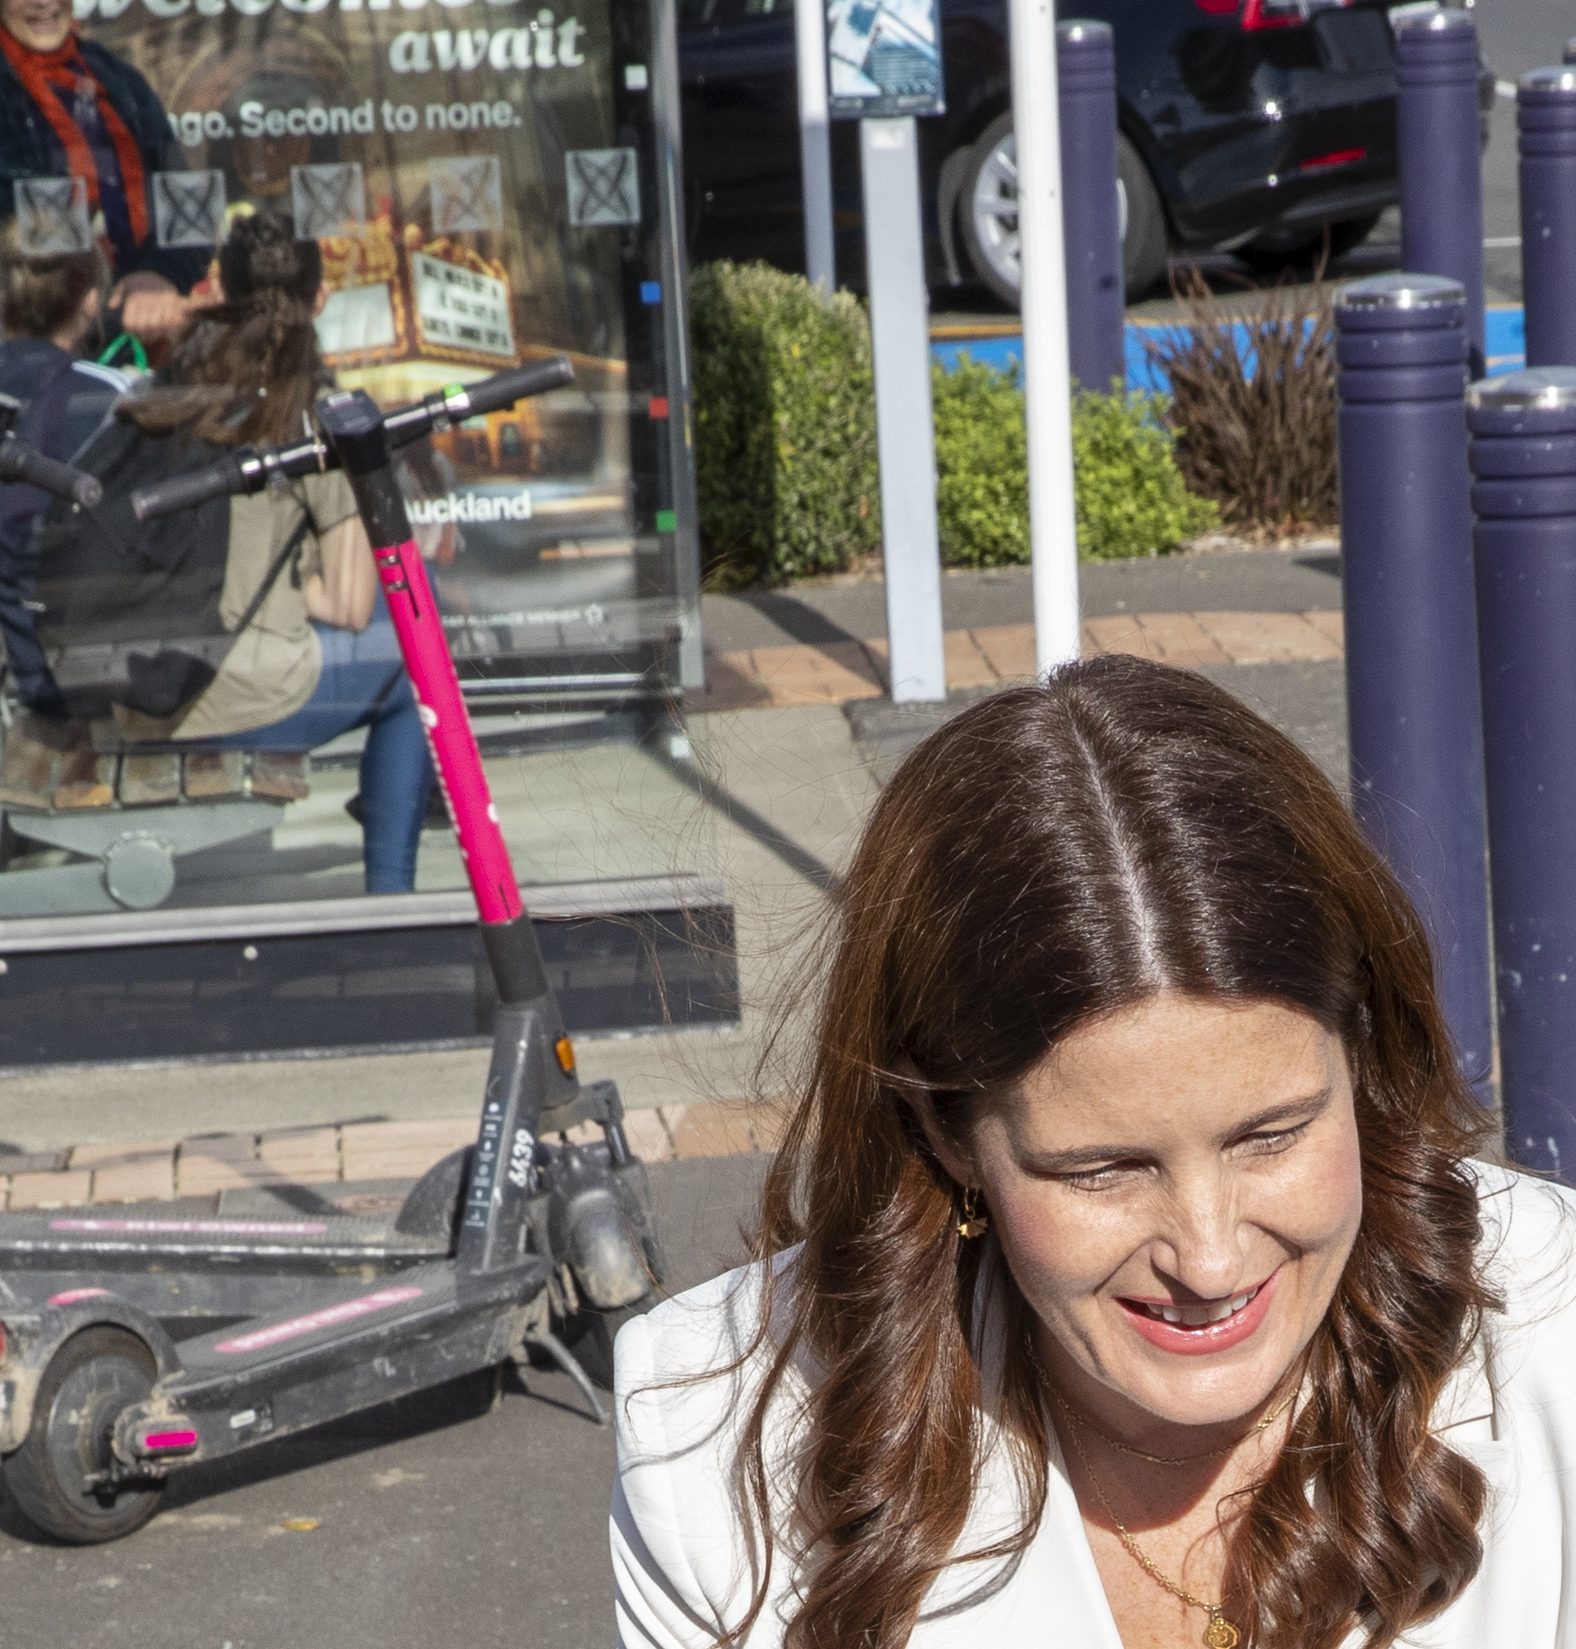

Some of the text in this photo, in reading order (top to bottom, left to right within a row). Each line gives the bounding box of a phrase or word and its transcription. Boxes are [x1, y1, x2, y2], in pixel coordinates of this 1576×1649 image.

[388, 9, 585, 74] await
[240, 100, 375, 138] Second
[380, 103, 419, 134] to
[426, 101, 523, 132] none.
[508, 1128, 535, 1188] 6439
